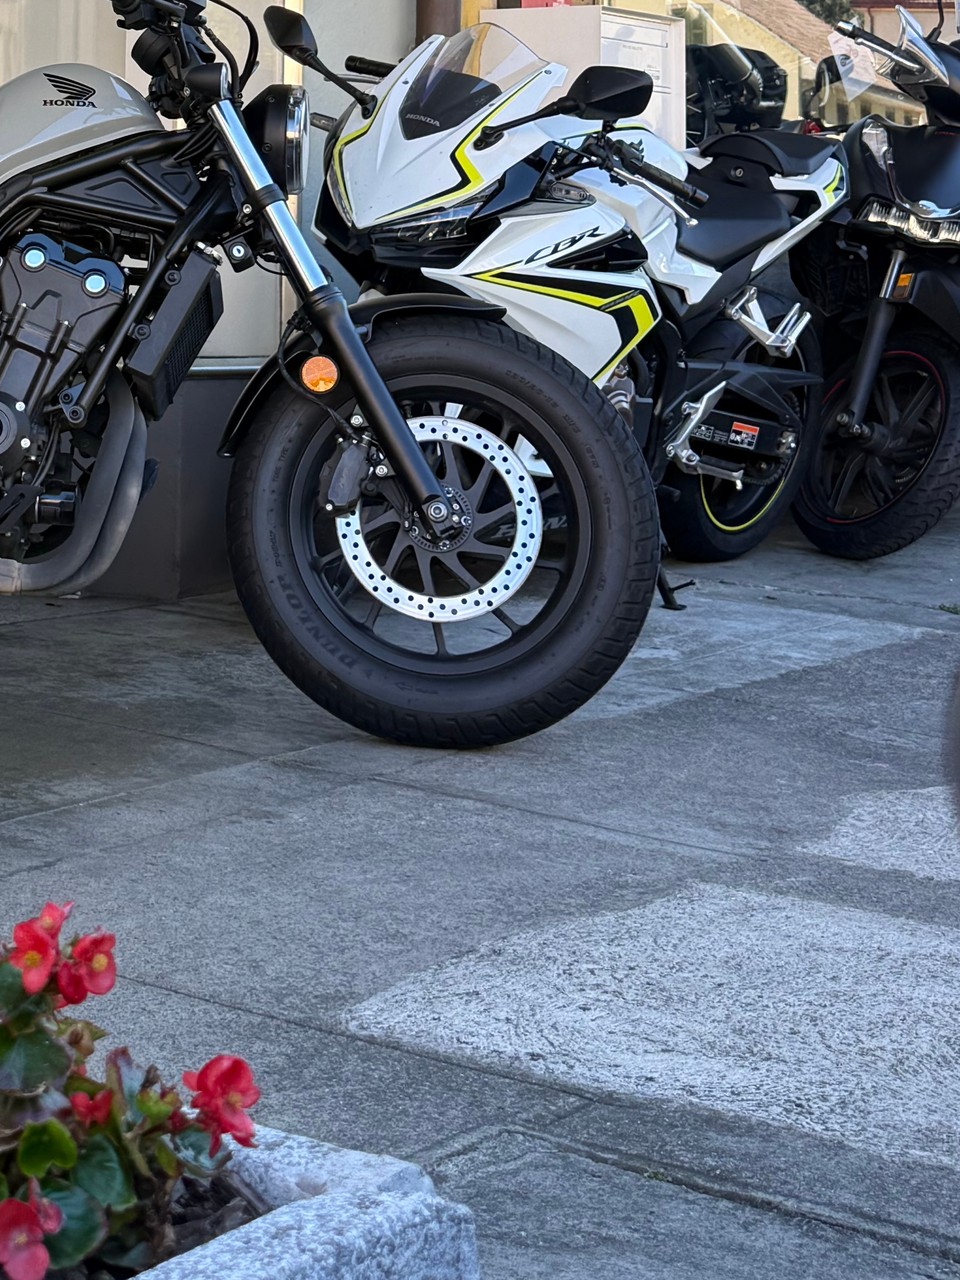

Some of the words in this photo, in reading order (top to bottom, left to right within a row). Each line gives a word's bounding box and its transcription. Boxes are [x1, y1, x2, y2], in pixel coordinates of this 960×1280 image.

[42, 99, 98, 109] HONDA
[405, 113, 441, 128] HONDA
[524, 225, 607, 265] CBR
[276, 573, 359, 670] DUNLOP
